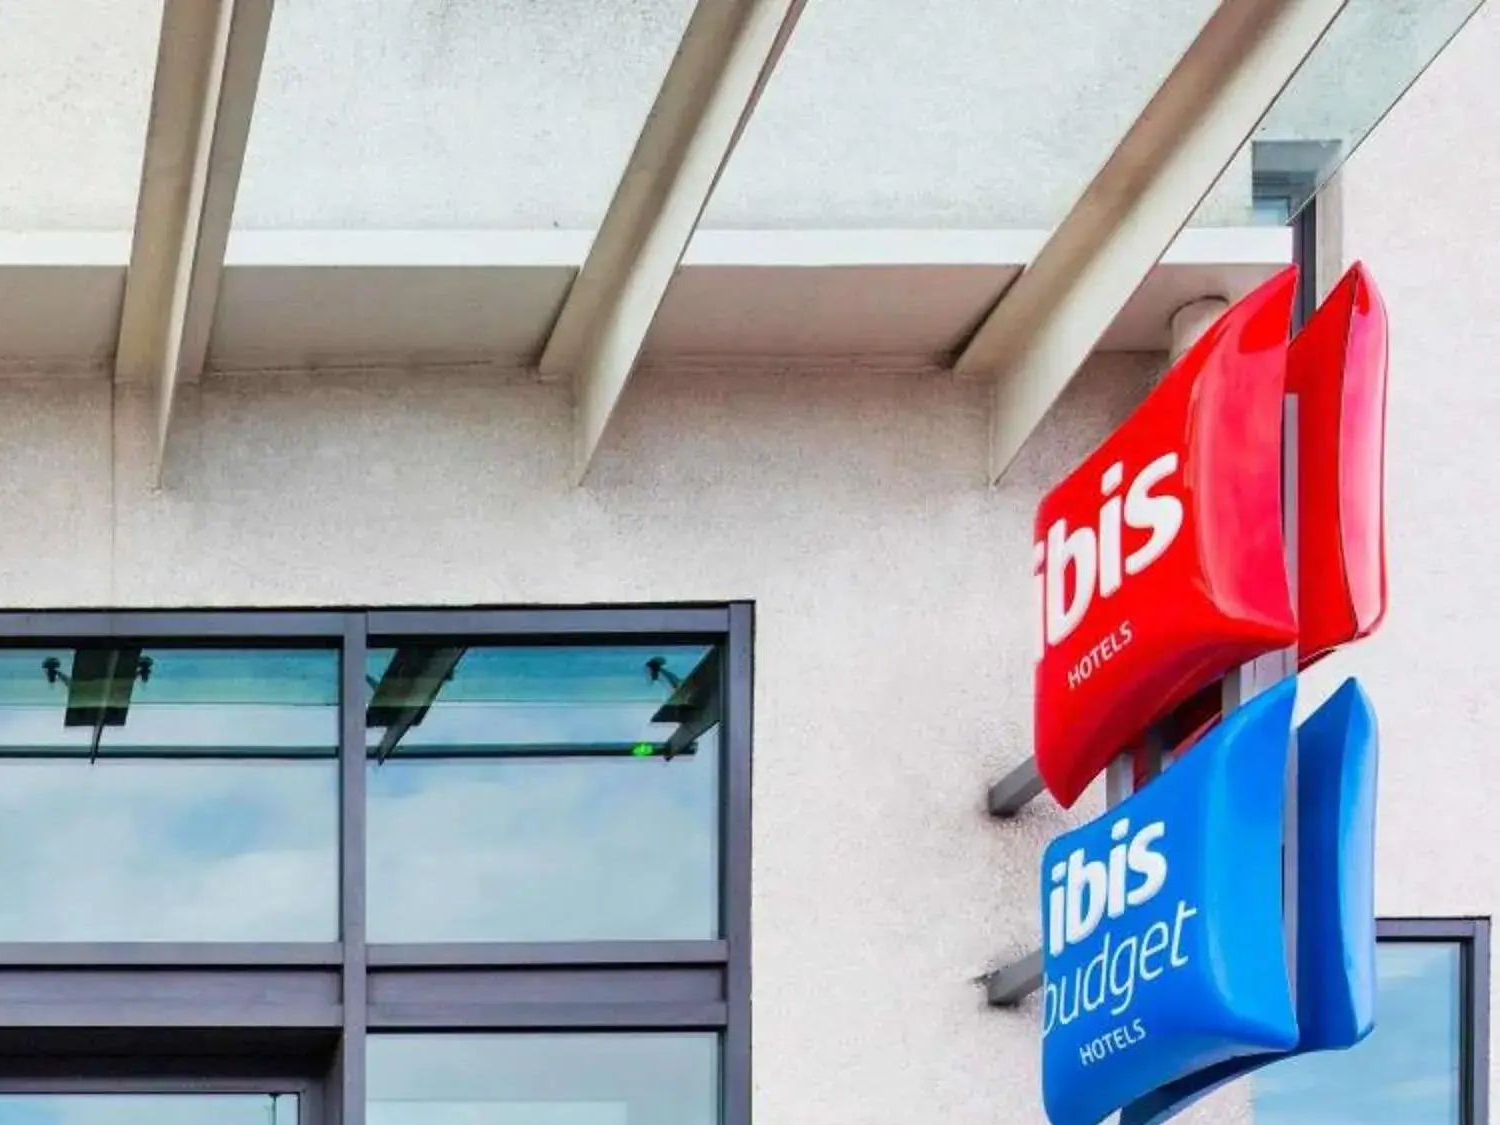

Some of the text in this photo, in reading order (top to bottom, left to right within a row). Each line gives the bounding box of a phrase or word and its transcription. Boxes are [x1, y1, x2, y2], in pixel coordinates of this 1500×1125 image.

[1066, 619, 1134, 690] HOTELS
[1049, 817, 1168, 957] ibis
[1079, 1019, 1147, 1066] HOTELS
